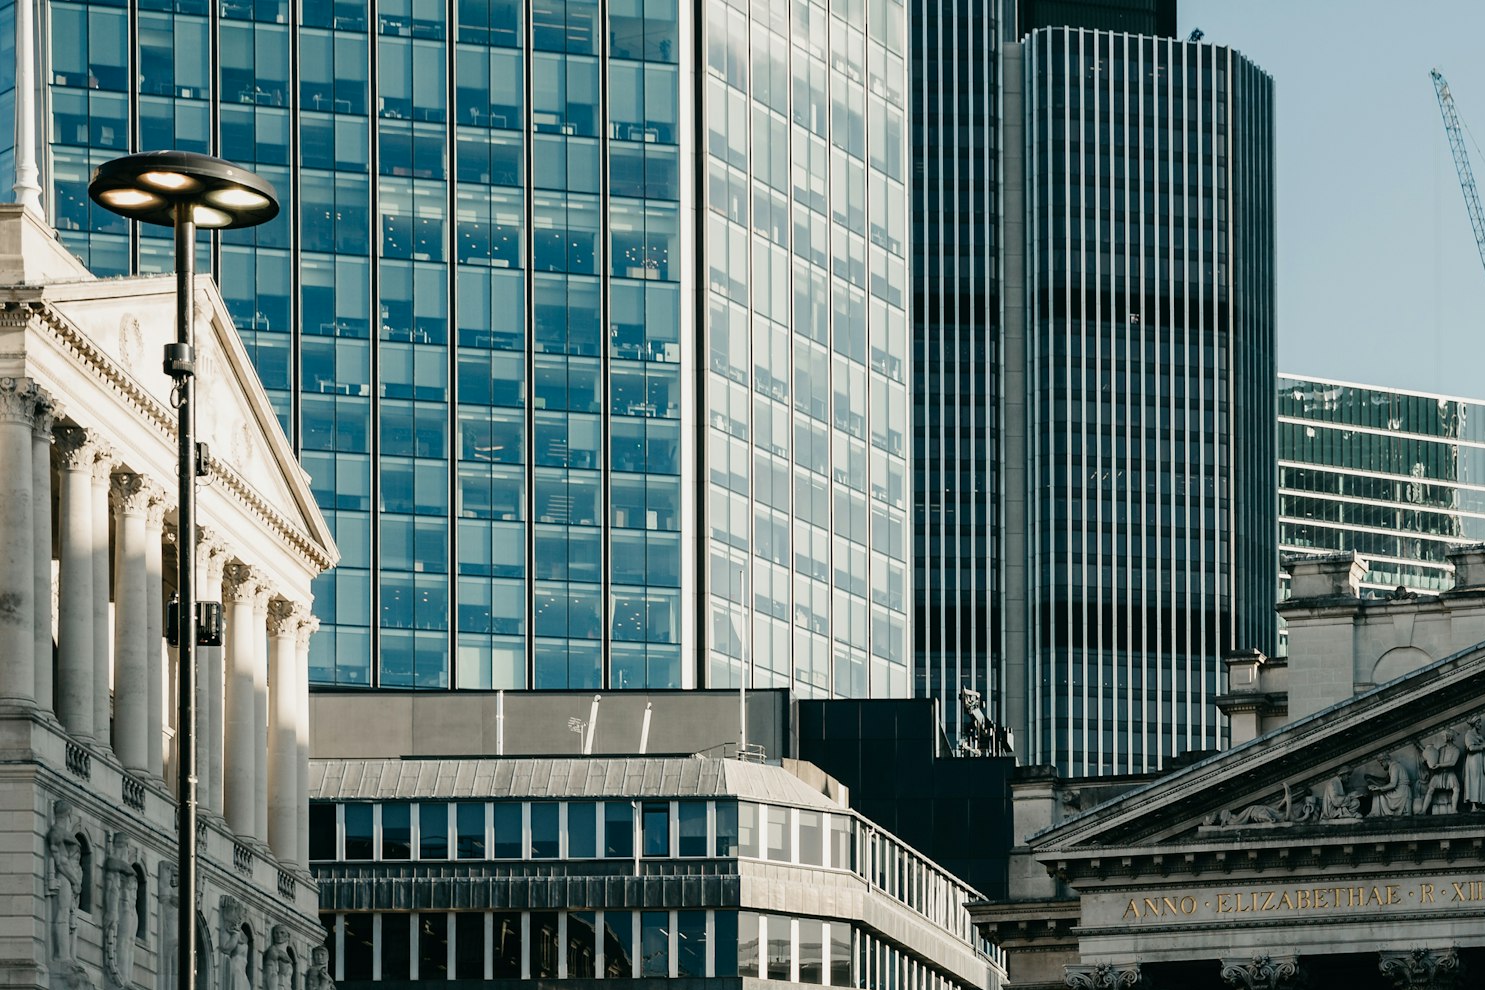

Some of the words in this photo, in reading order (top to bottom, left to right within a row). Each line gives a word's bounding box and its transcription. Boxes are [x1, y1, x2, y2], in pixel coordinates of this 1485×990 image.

[1122, 895, 1198, 920] ANNO
[1215, 883, 1402, 914] ELIZABETHAE
[1420, 883, 1437, 904] R
